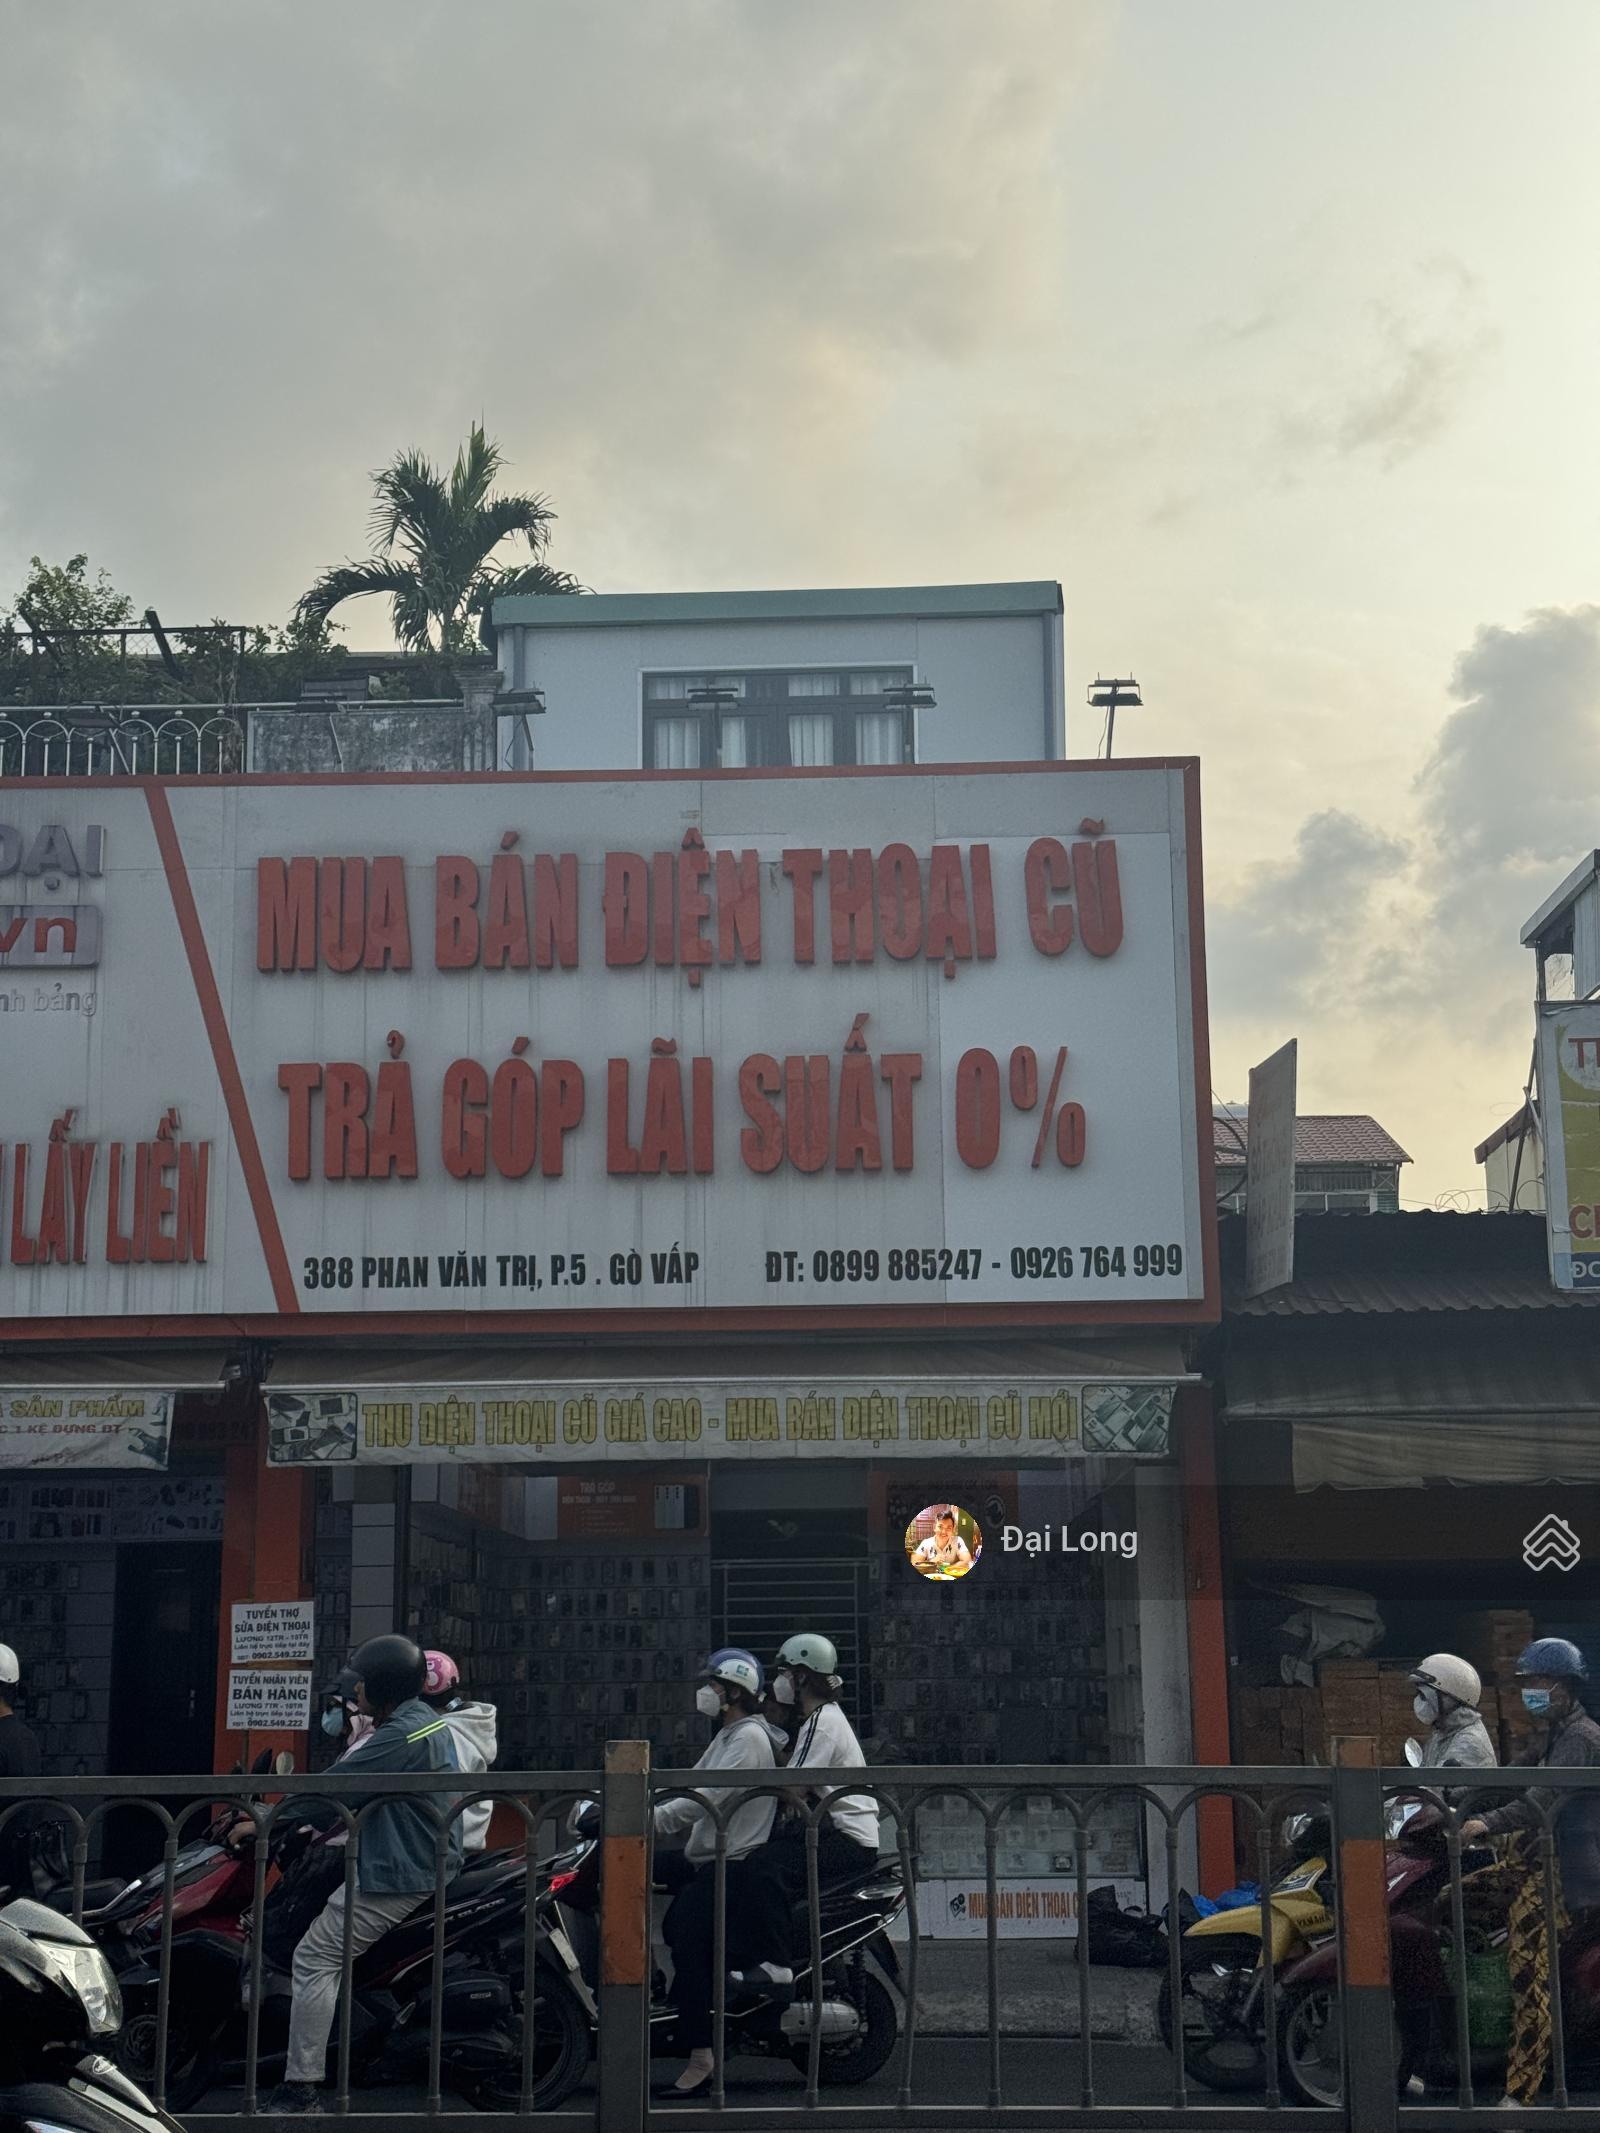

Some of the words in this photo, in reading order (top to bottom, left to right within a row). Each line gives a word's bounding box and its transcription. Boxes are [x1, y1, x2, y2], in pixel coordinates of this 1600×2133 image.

[257, 856, 412, 972] MUA
[435, 831, 579, 970] BÁN
[602, 827, 761, 988] ĐIỆN
[782, 842, 997, 979] THOẠI
[1024, 817, 1124, 958] CŨ
[34, 983, 97, 1017] bảng
[278, 1030, 418, 1181] TRẢ
[442, 1036, 585, 1179] GÓP
[606, 1037, 714, 1175] LÃI
[739, 1012, 922, 1174] SUẤT
[955, 1045, 1086, 1169] 0%
[10, 1108, 97, 1265] LẤY
[106, 1107, 210, 1264] LIỀN
[303, 1256, 353, 1290] 388
[362, 1255, 428, 1289] PHAN
[438, 1250, 487, 1286] VĂN
[497, 1254, 543, 1292] TRỊ,
[551, 1254, 586, 1286] P.5
[610, 1248, 642, 1286] GÒ
[651, 1241, 699, 1284] VẤP
[765, 1251, 804, 1283] ĐT:
[813, 1250, 879, 1282] 0899
[888, 1249, 982, 1281] 885247
[1011, 1247, 1073, 1279] 0926
[1080, 1246, 1126, 1278] 764
[1133, 1244, 1182, 1277] 999
[10, 1394, 63, 1418] SẢN
[69, 1392, 145, 1418] PHẨM
[362, 1403, 412, 1447] THU
[419, 1395, 475, 1454] ĐIỆN
[482, 1400, 555, 1453] THOẠI
[563, 1393, 597, 1444] CŨ
[604, 1392, 647, 1443] GIÁ
[653, 1398, 702, 1442] CAO
[725, 1397, 779, 1442] MUA
[786, 1390, 835, 1441] BÁN
[842, 1389, 899, 1448] ĐIỆN
[905, 1395, 980, 1448] THOẠI
[987, 1389, 1021, 1440] CŨ
[1029, 1389, 1078, 1441] MỚI
[235, 1620, 253, 1633] SỬA
[257, 1620, 279, 1634] ĐIỆN
[282, 1621, 310, 1634] THOẠI
[246, 1605, 277, 1620] TUYỂN
[280, 1607, 299, 1620] THỢ
[232, 1672, 261, 1685] TUYỂN
[263, 1674, 286, 1685] NHÂN
[289, 1673, 308, 1685] VIÊN
[233, 1686, 262, 1700] BÁN
[268, 1686, 307, 1700] HÀNG
[1016, 1886, 1039, 1924] ĐIỆN
[1041, 1891, 1071, 1924] THOẠI
